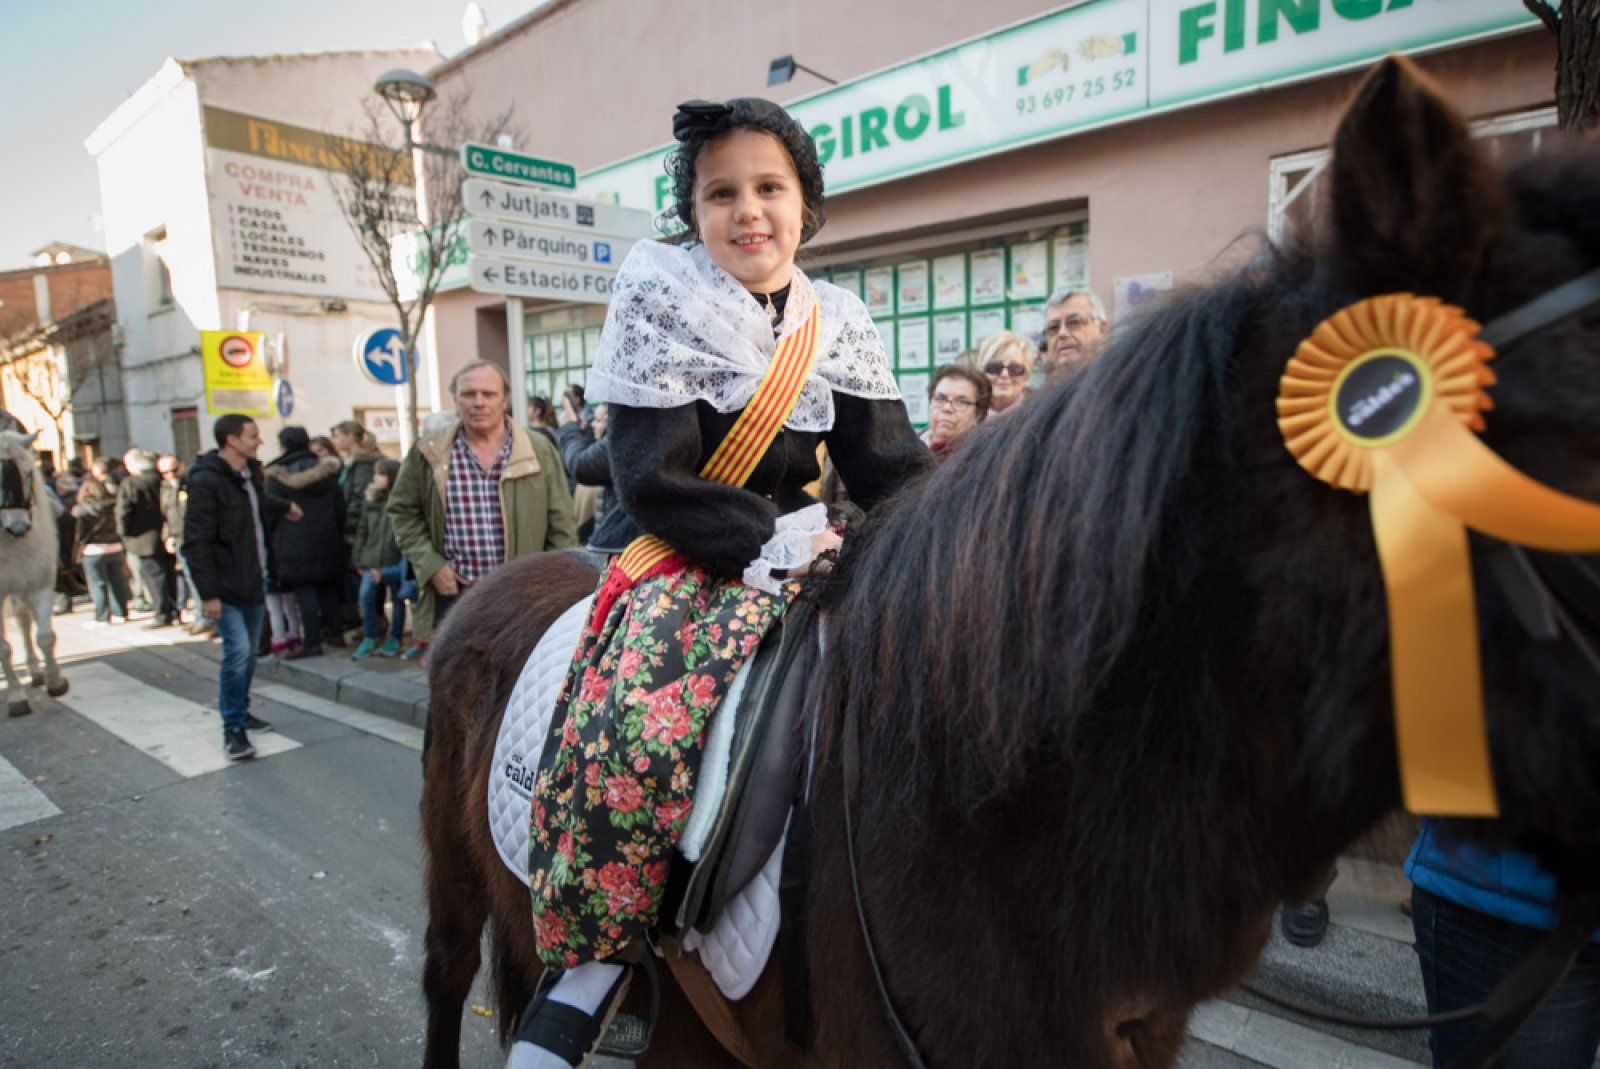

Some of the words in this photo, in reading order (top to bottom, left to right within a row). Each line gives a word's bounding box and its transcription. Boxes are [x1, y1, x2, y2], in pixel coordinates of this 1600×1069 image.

[1178, 0, 1414, 66] FIN
[1016, 96, 1037, 115] 93
[1043, 84, 1075, 108] 697
[1083, 76, 1105, 99] 25
[1112, 67, 1136, 91] 52
[810, 84, 965, 164] GIROL
[224, 162, 316, 193] COMPRA
[471, 153, 488, 169] C.
[492, 157, 571, 183] Cervantes
[239, 182, 308, 208] VENTA
[500, 192, 570, 220] Jutjats
[239, 217, 288, 233] CASAS
[239, 230, 305, 247] LOCALES
[501, 228, 588, 261] Pàrquing
[504, 266, 579, 291] Estació
